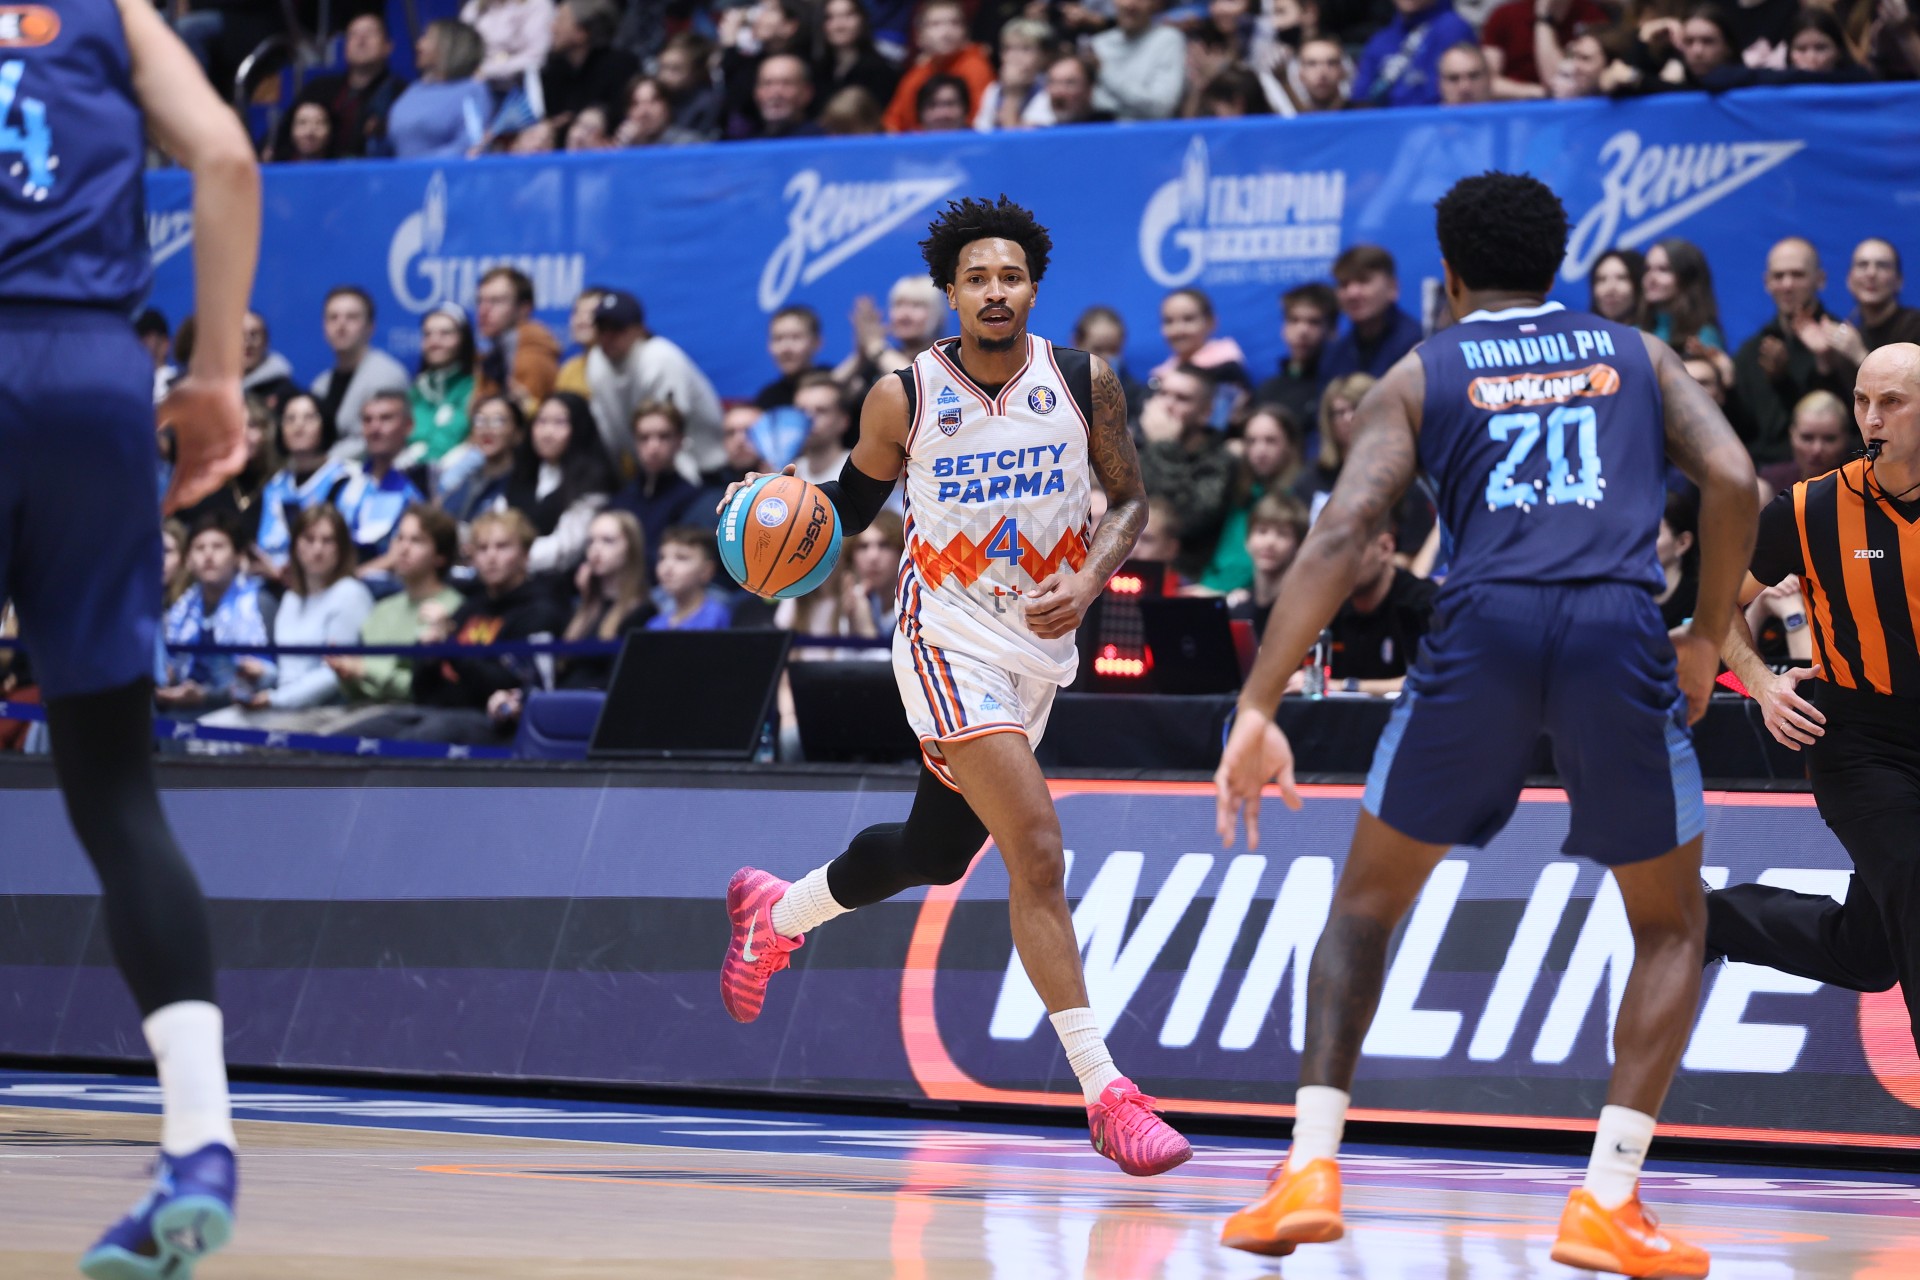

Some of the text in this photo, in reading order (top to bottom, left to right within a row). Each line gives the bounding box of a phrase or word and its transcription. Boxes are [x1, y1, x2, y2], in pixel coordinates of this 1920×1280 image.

[1459, 329, 1615, 370] RANDOLPH
[936, 395, 960, 405] PEAK
[1479, 373, 1590, 405] WINLINE
[932, 442, 1068, 477] BETCITY
[1486, 405, 1606, 512] 20
[937, 468, 1065, 504] PARMA
[787, 494, 828, 564] JÖGEL
[985, 518, 1024, 567] 4
[1853, 549, 1884, 559] ZEDO
[988, 849, 1854, 1073] WINLINE
